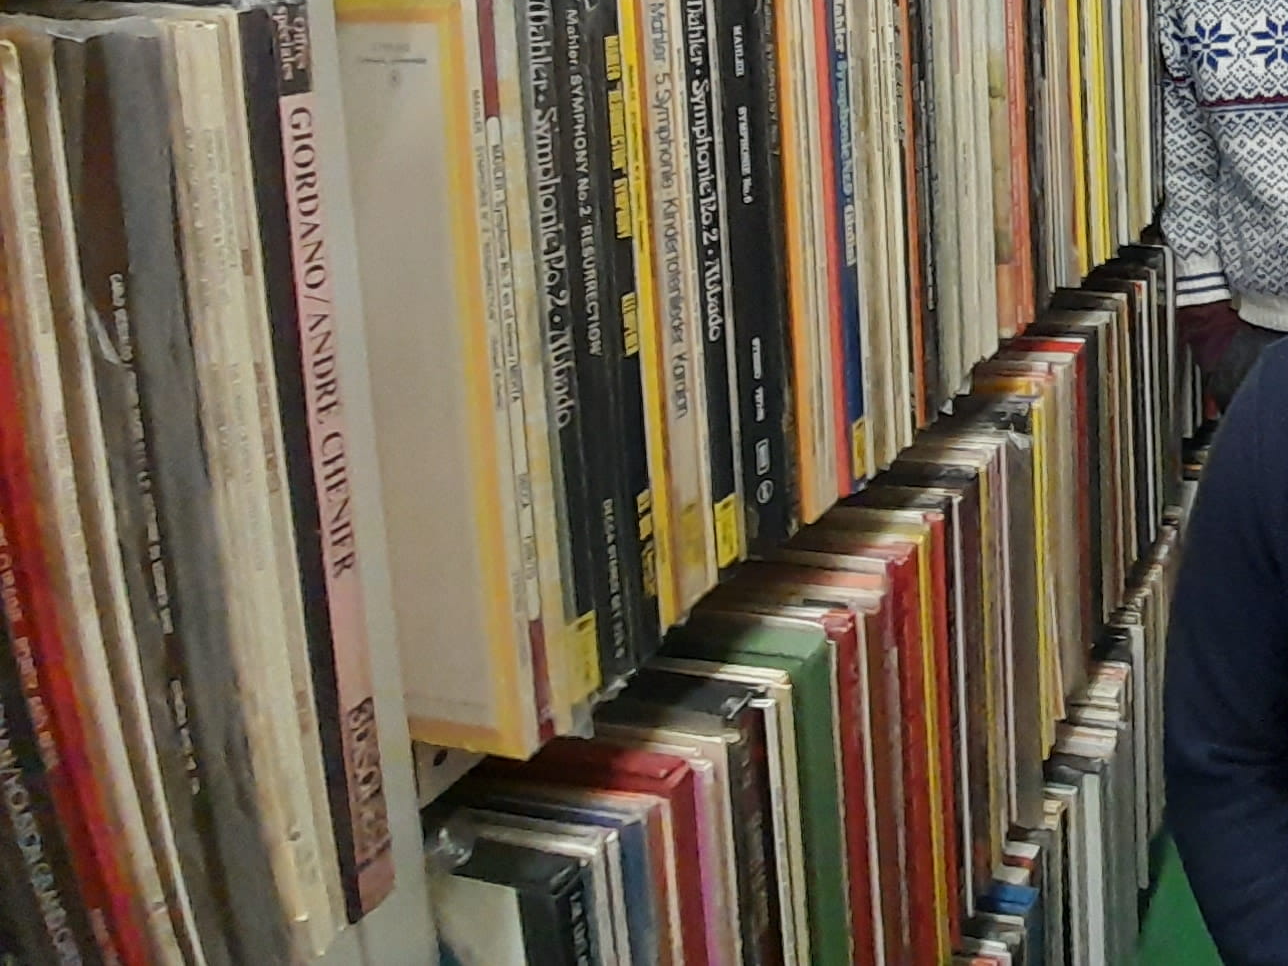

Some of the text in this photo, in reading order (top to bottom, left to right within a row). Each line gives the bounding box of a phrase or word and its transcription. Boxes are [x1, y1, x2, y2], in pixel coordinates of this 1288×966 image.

[291, 15, 310, 71] Offres
[649, 1, 669, 63] Mahler
[732, 24, 745, 78] MAHLER
[570, 74, 590, 173] SYMPHONY
[737, 105, 751, 176] SYMPHONIE
